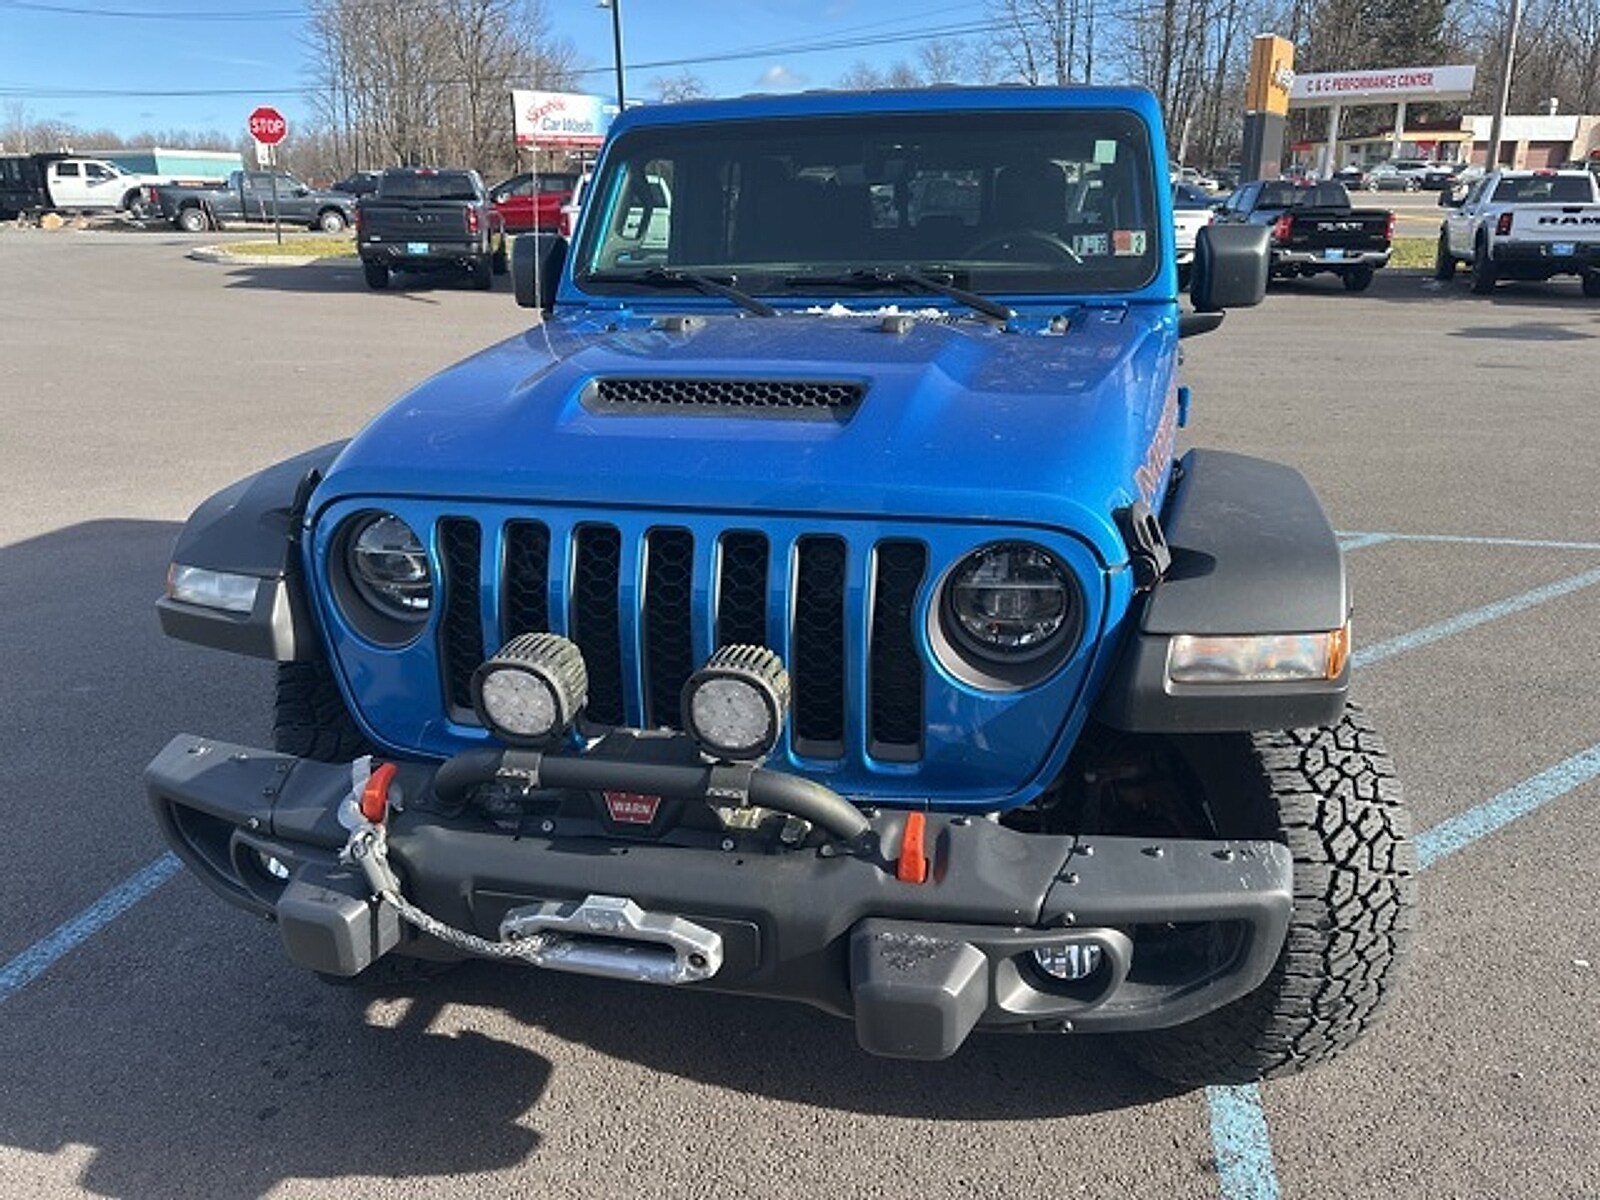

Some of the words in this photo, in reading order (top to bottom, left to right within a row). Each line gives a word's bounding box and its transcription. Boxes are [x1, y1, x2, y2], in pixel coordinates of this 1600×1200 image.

[1333, 75, 1396, 90] PERFORMANCE
[1398, 72, 1434, 87] CENTER
[252, 117, 284, 134] STOP
[542, 117, 560, 131] Car
[563, 118, 593, 133] Wash
[613, 800, 651, 814] WARN
